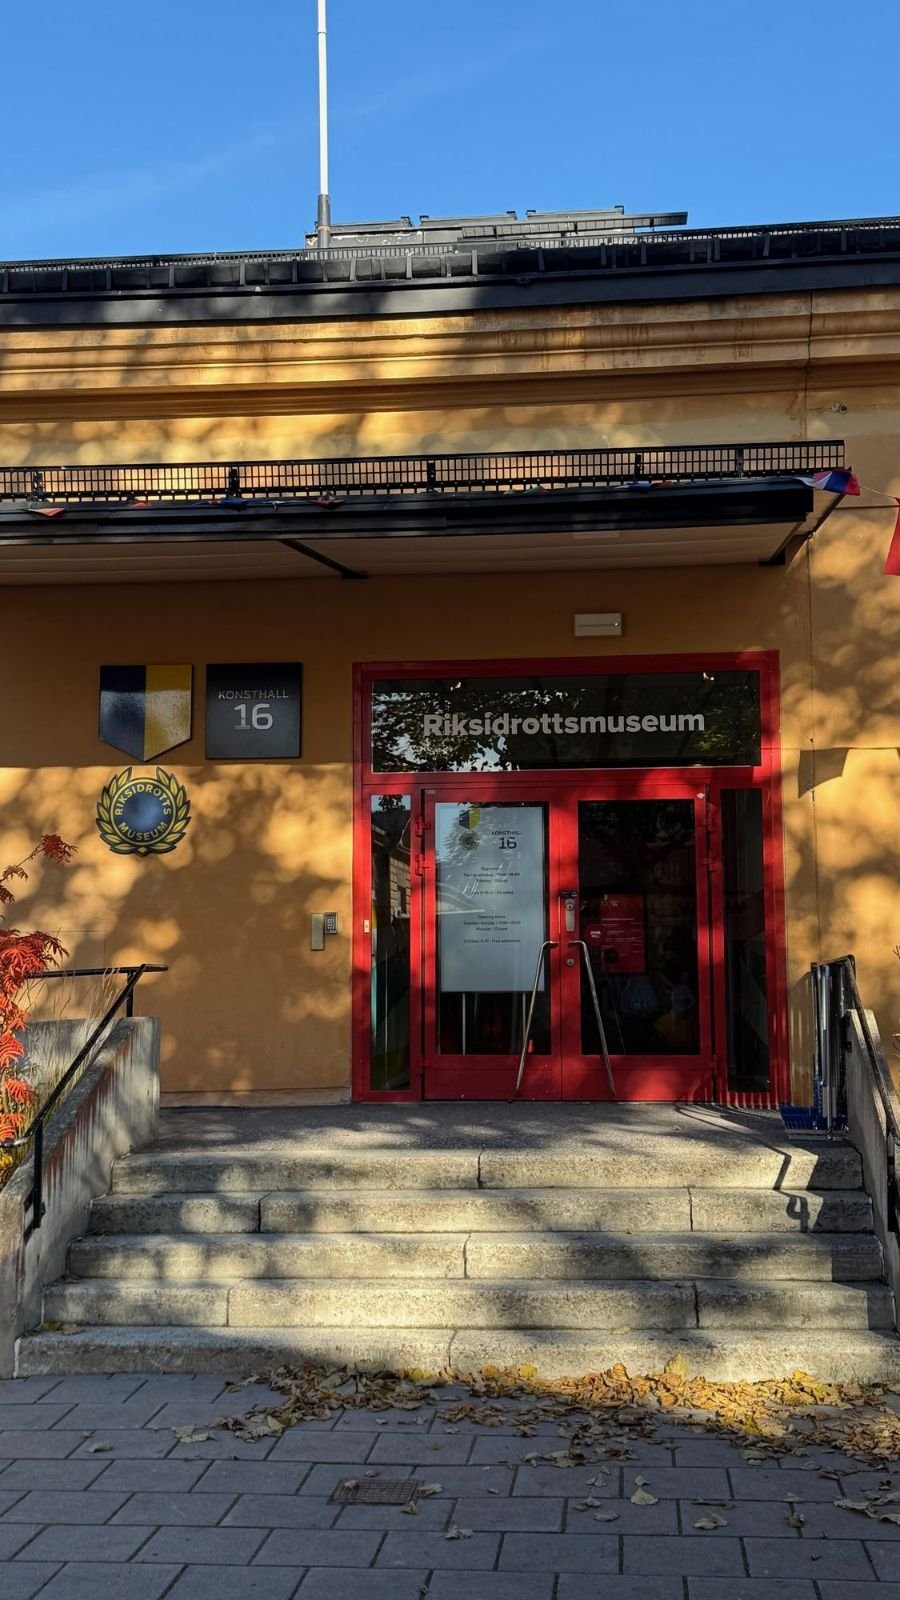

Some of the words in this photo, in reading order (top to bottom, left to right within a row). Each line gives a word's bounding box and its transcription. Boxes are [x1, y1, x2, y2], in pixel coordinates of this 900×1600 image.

[218, 689, 289, 700] KONSTHALL
[234, 703, 273, 730] 16
[423, 711, 705, 737] Riksidrottsmuseum
[114, 784, 172, 816] RIKSIDROTTS
[118, 821, 168, 841] MUSEUM
[498, 837, 517, 849] 16
